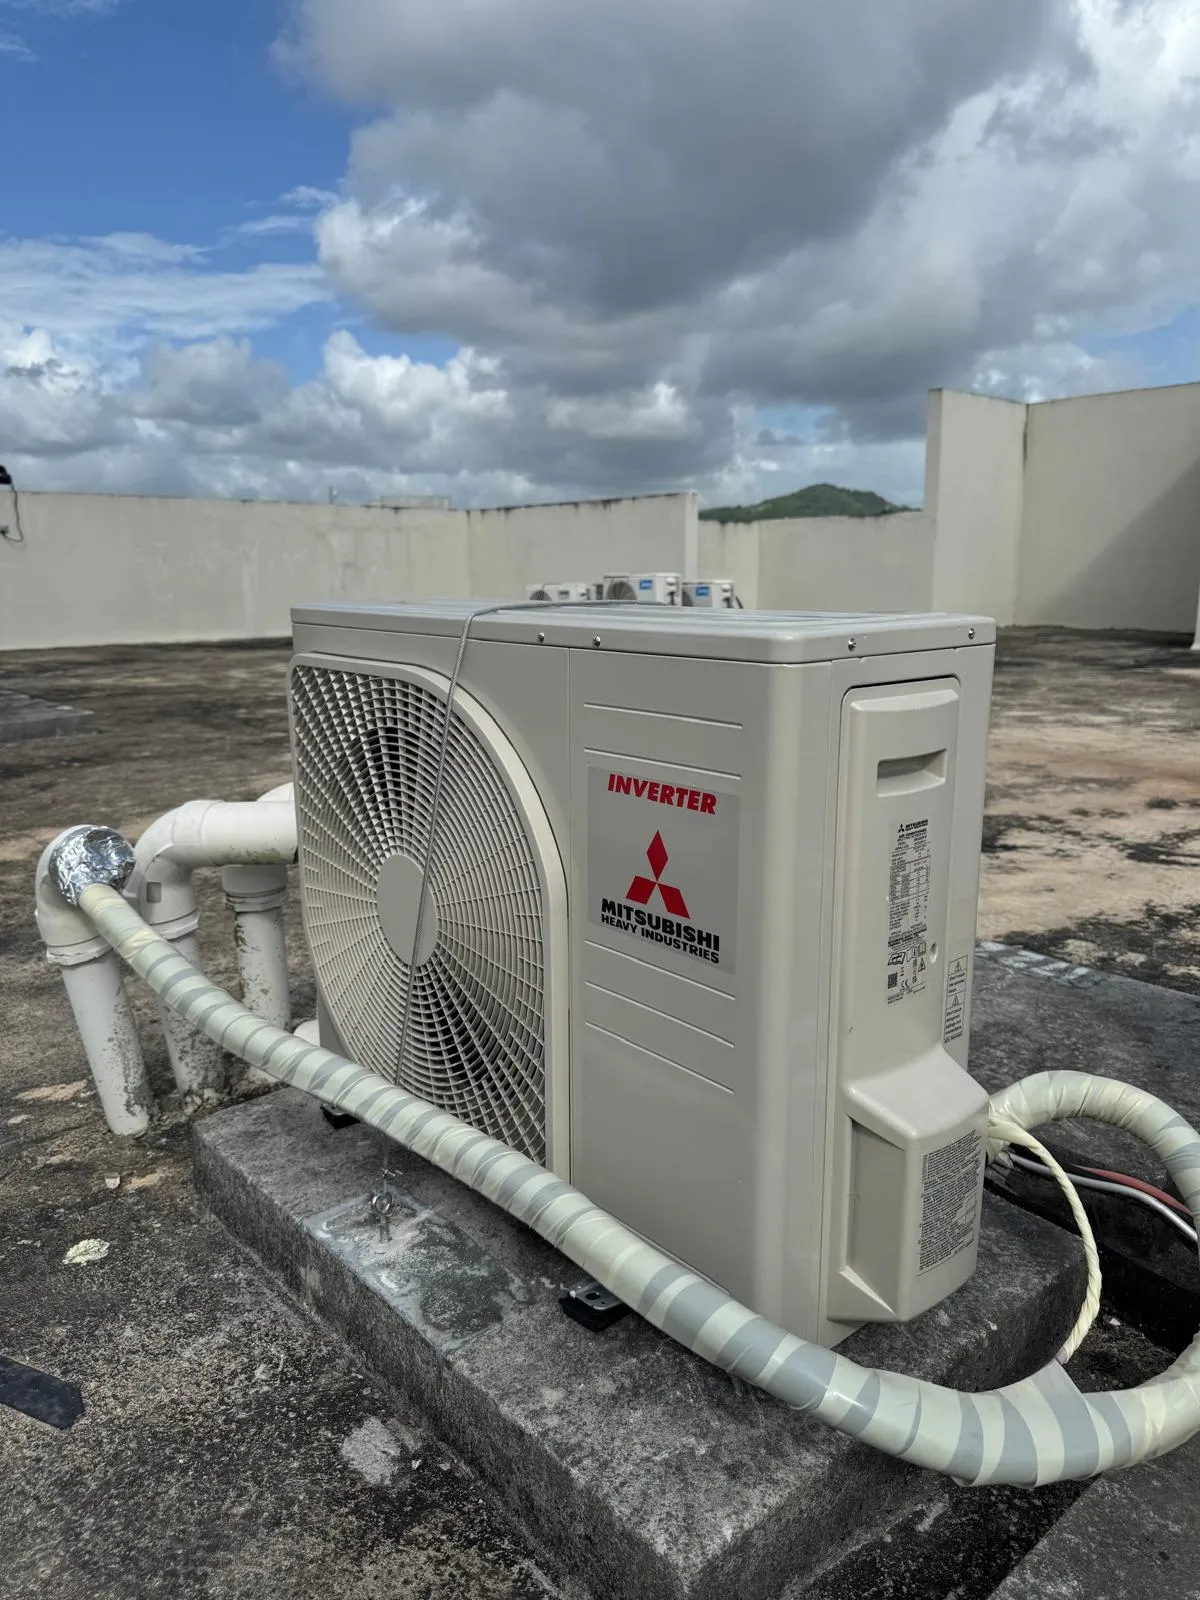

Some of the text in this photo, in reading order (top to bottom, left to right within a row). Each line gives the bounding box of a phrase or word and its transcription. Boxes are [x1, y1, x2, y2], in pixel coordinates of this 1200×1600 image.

[607, 773, 717, 815] INVERTER
[601, 898, 719, 952] MITSUBISHI
[601, 913, 719, 964] HEAVY INDUSTRIES
